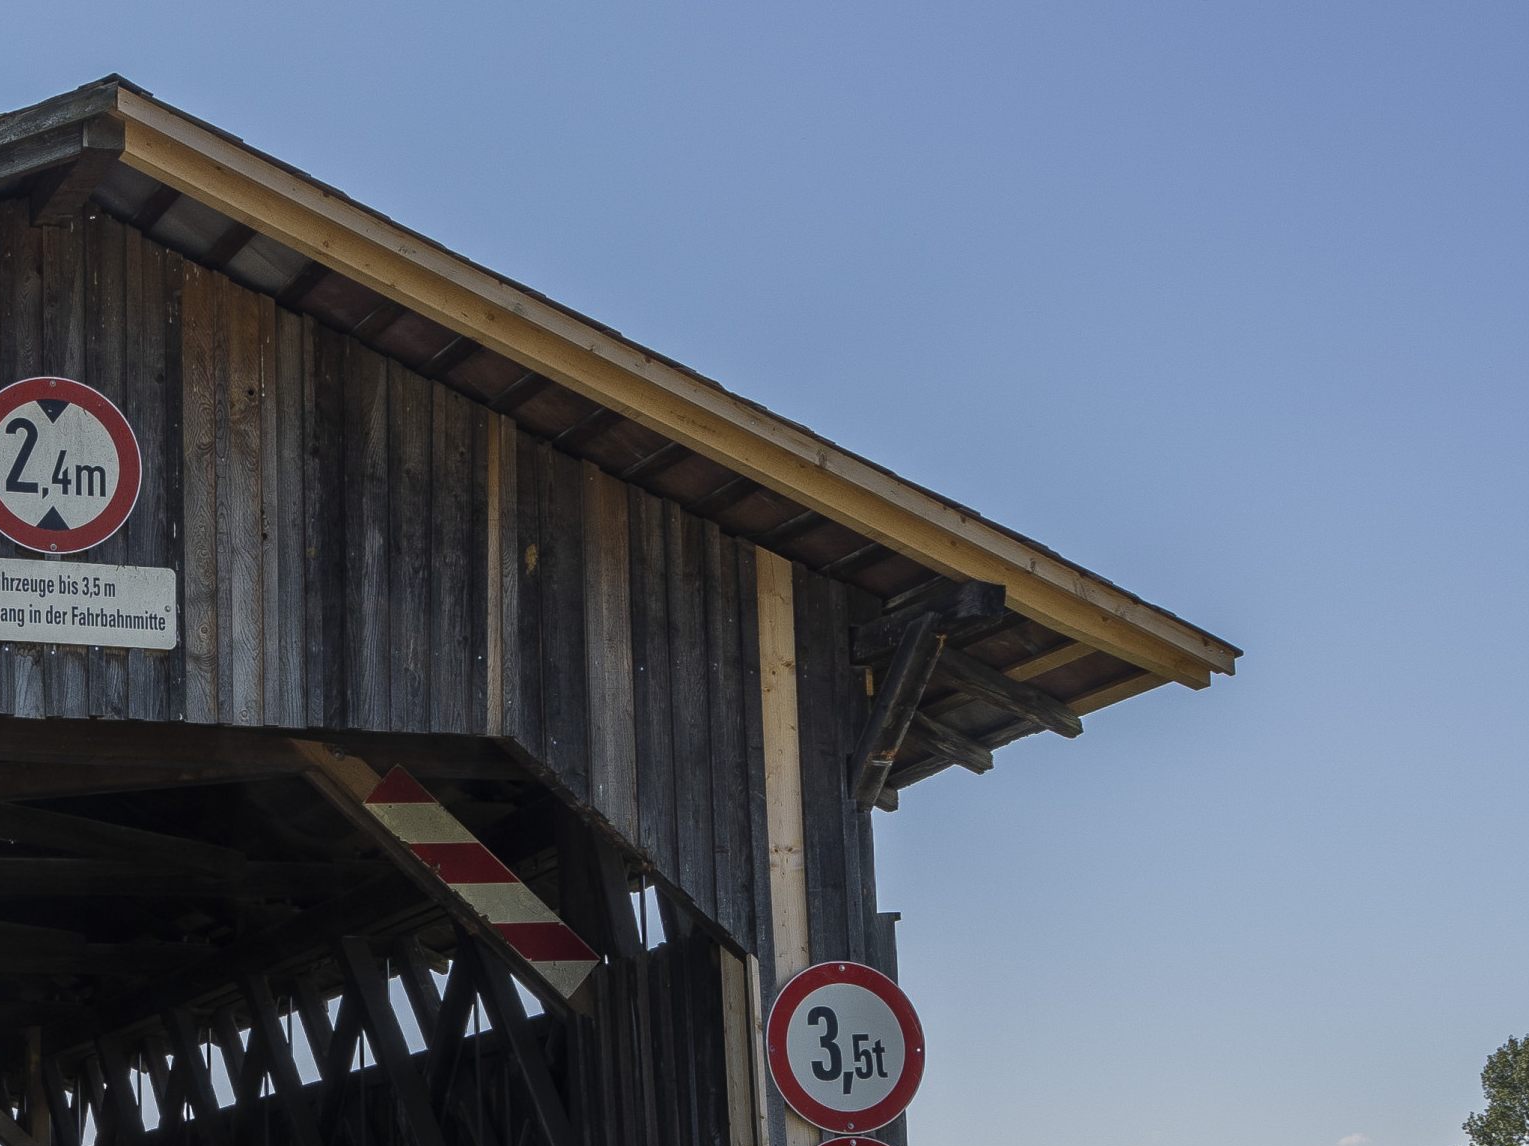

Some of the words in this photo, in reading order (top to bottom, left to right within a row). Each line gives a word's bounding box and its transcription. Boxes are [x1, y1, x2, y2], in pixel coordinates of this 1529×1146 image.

[4, 416, 107, 500] 2,4m
[58, 574, 79, 596] bis
[82, 576, 101, 598] 3,5
[104, 582, 116, 598] m
[29, 603, 42, 624] in
[45, 605, 68, 626] der
[71, 606, 167, 632] Fahrbahnmitte
[806, 1005, 889, 1096] 3,5t
